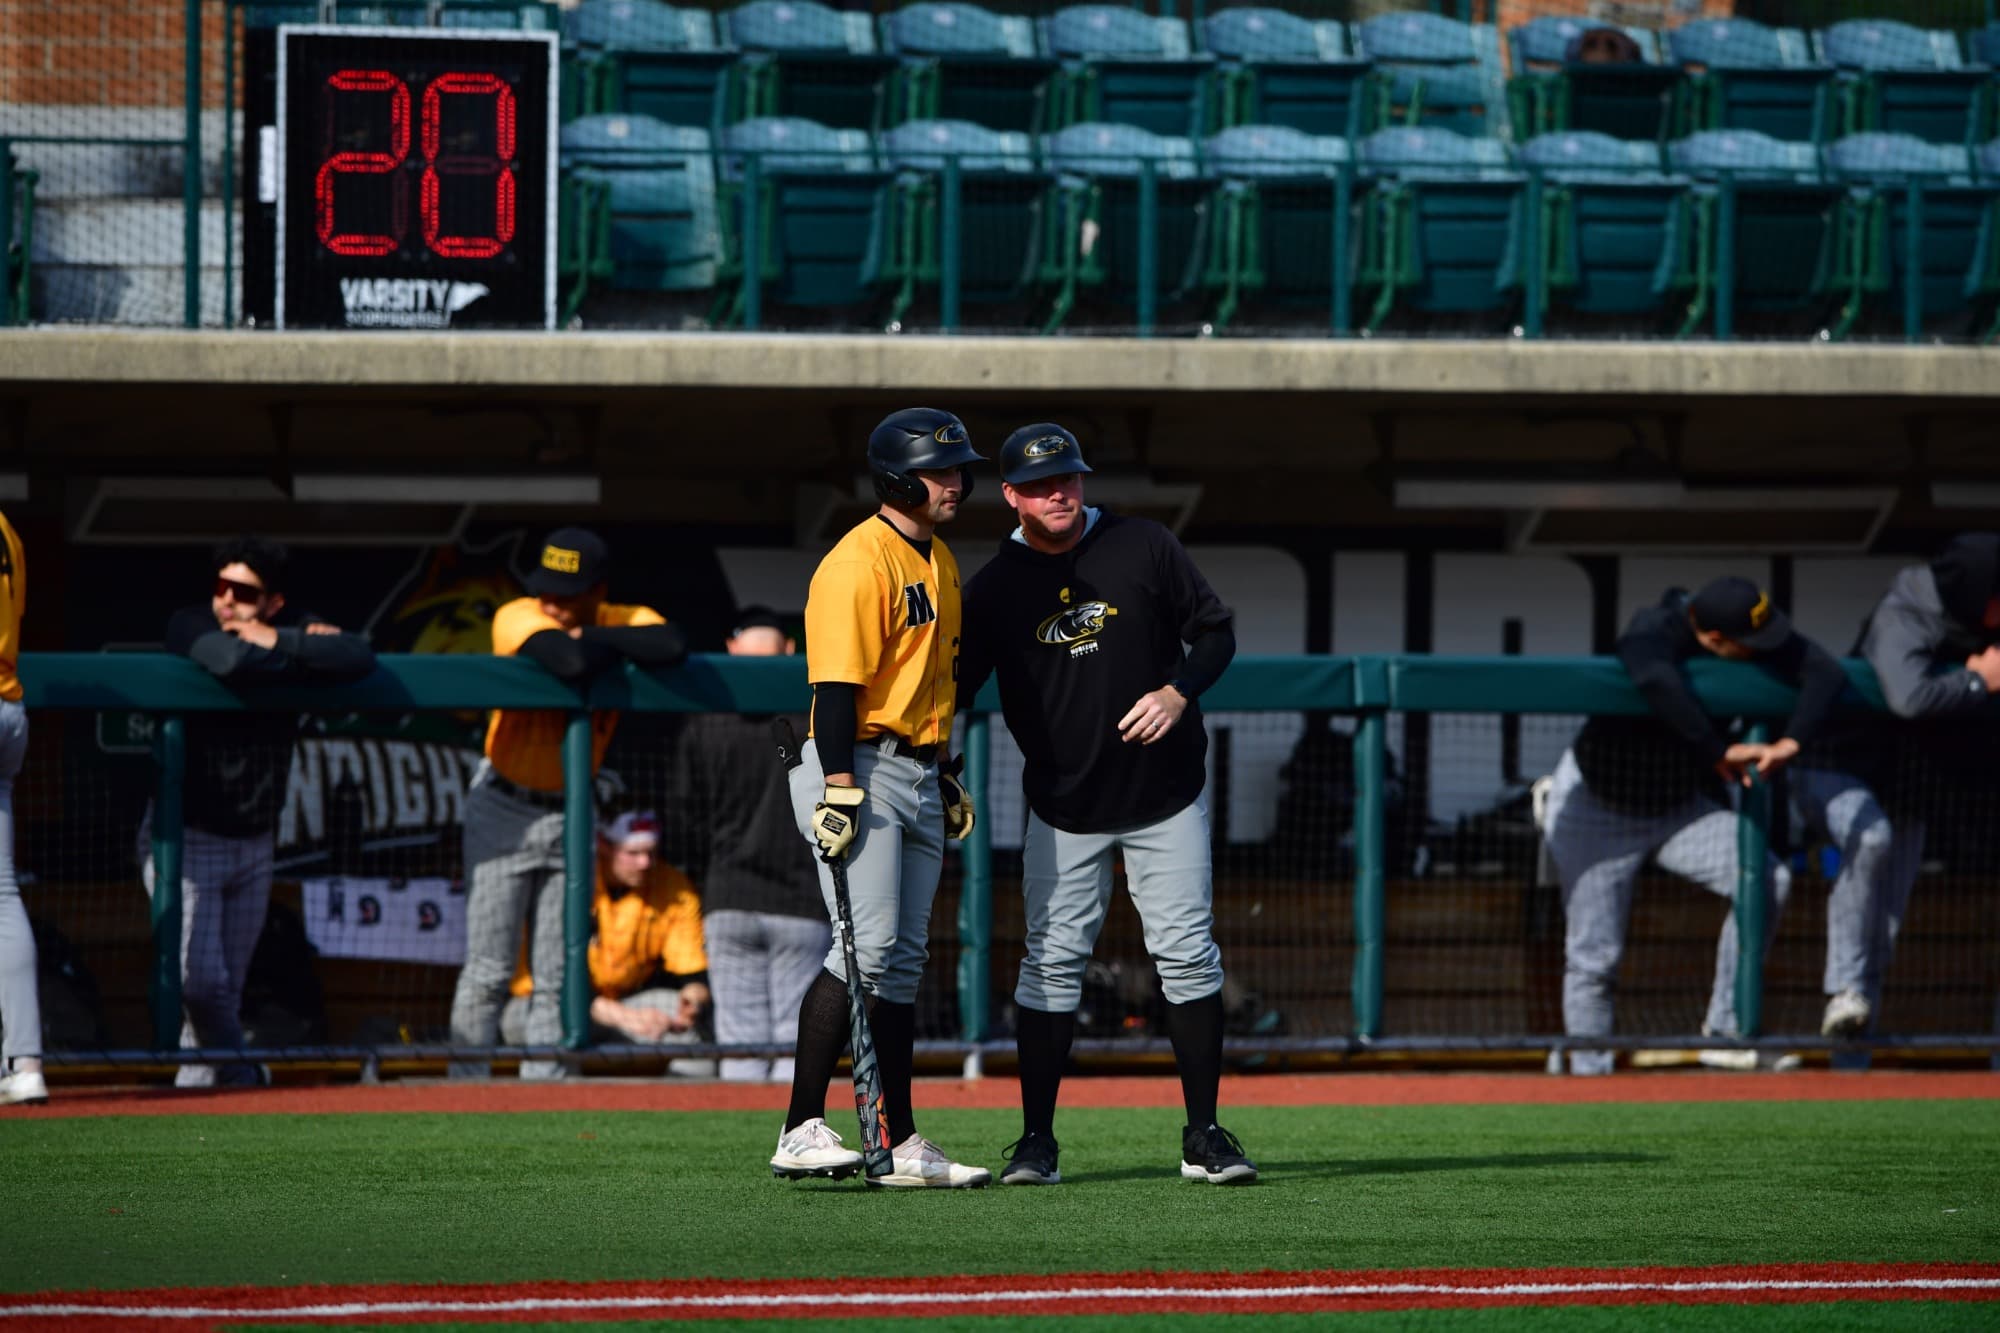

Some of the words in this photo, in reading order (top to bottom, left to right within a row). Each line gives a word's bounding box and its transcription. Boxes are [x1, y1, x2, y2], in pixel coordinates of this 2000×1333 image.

[315, 70, 516, 258] 20
[340, 278, 449, 312] VARSITY
[904, 581, 937, 629] M
